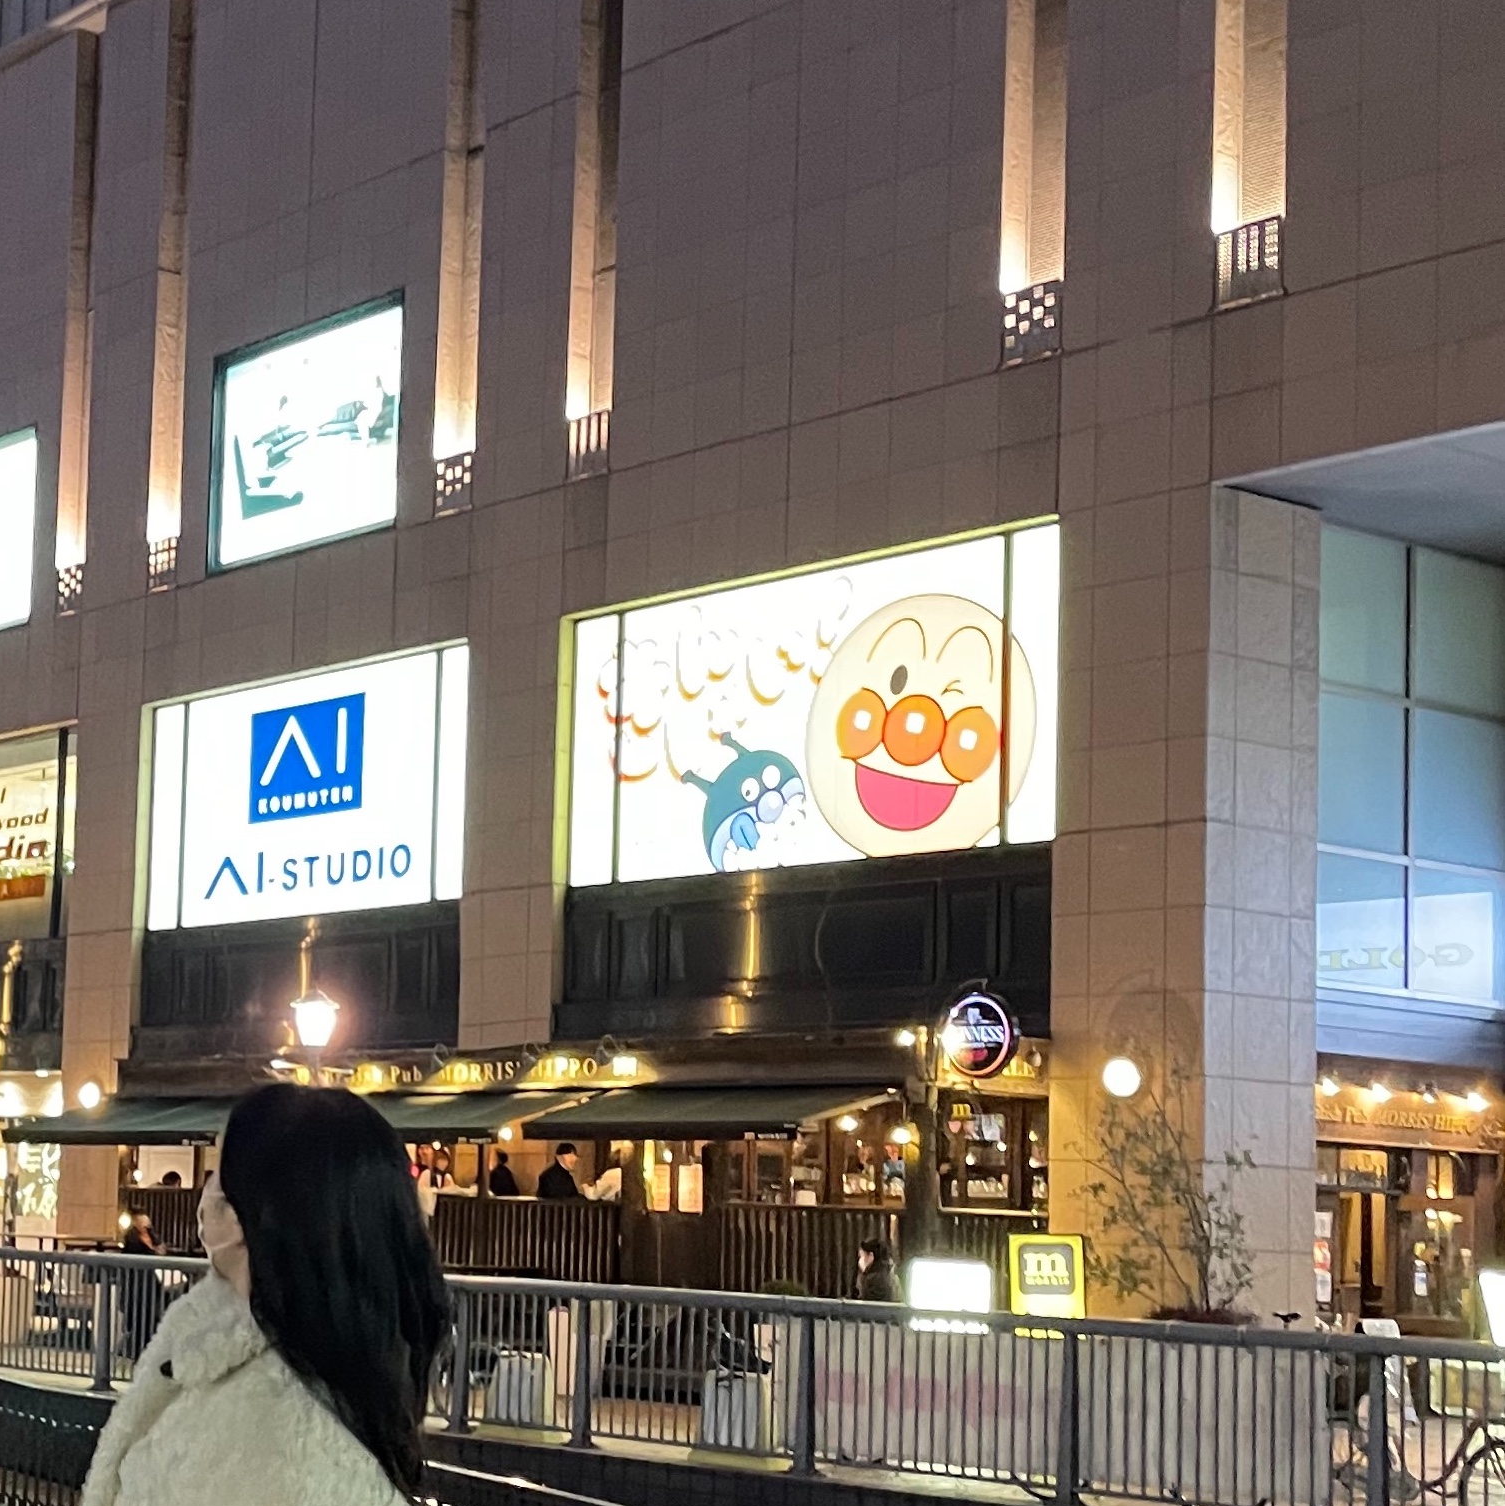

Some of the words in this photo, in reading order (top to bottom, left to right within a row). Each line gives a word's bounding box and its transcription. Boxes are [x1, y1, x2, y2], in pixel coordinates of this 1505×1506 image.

[259, 707, 348, 787] AI
[204, 844, 412, 900] AI-STUDIO
[390, 1064, 423, 1084] Pub
[1023, 1252, 1069, 1277] m
